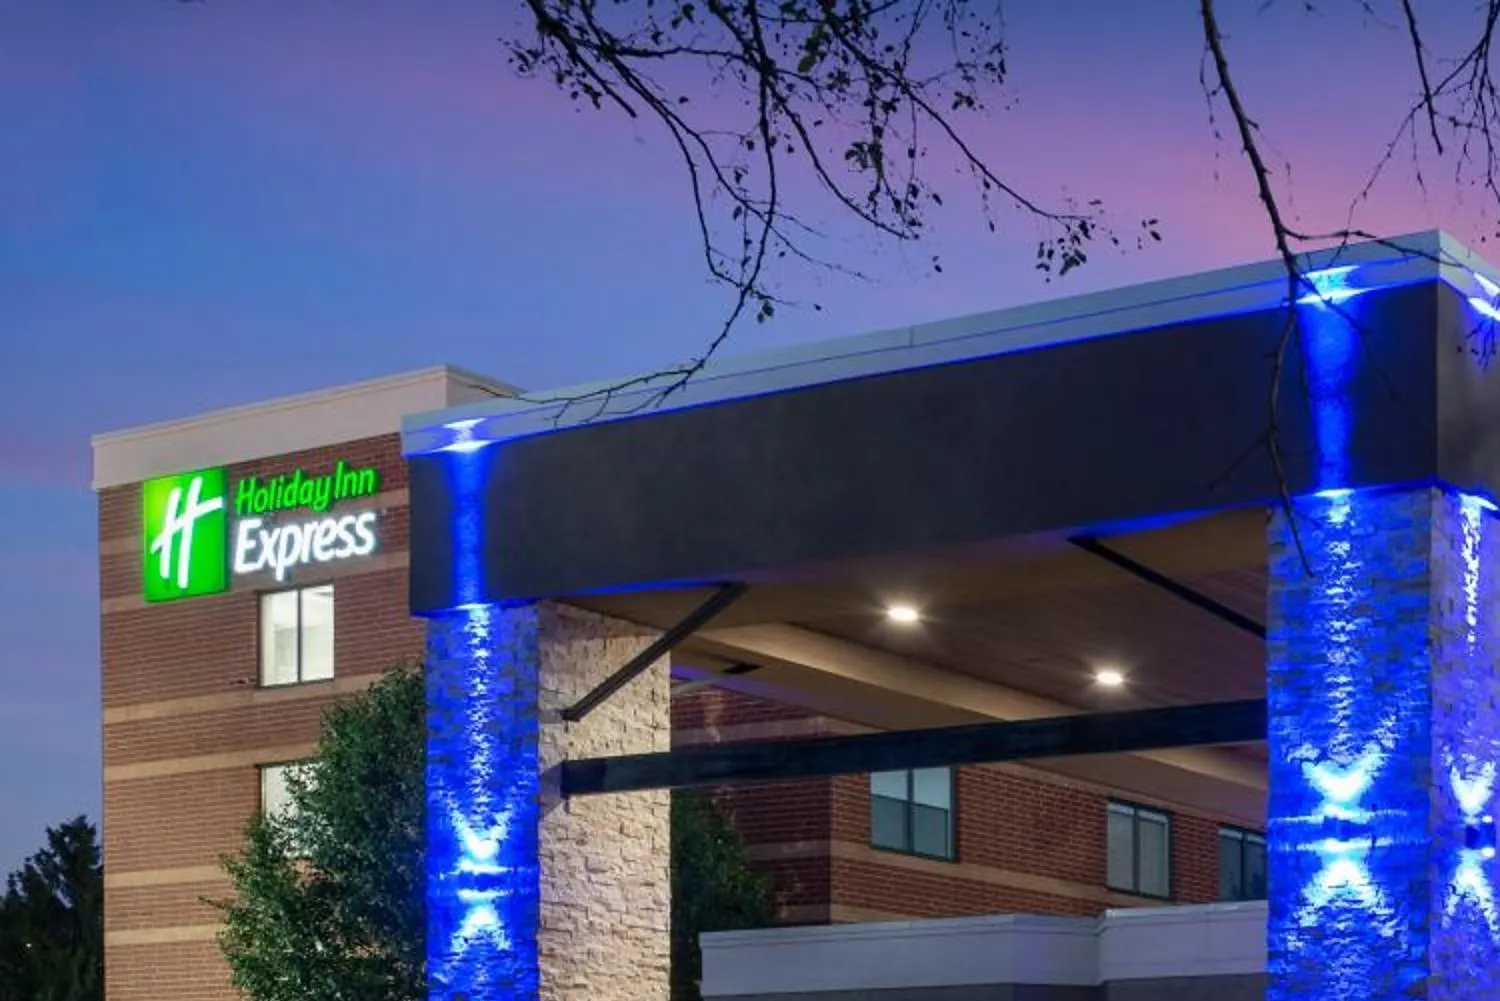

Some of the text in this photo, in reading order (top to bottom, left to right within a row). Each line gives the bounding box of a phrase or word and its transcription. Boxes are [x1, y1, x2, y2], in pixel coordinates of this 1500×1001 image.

[235, 460, 376, 515] Holiday Inn
[234, 512, 376, 581] Express
